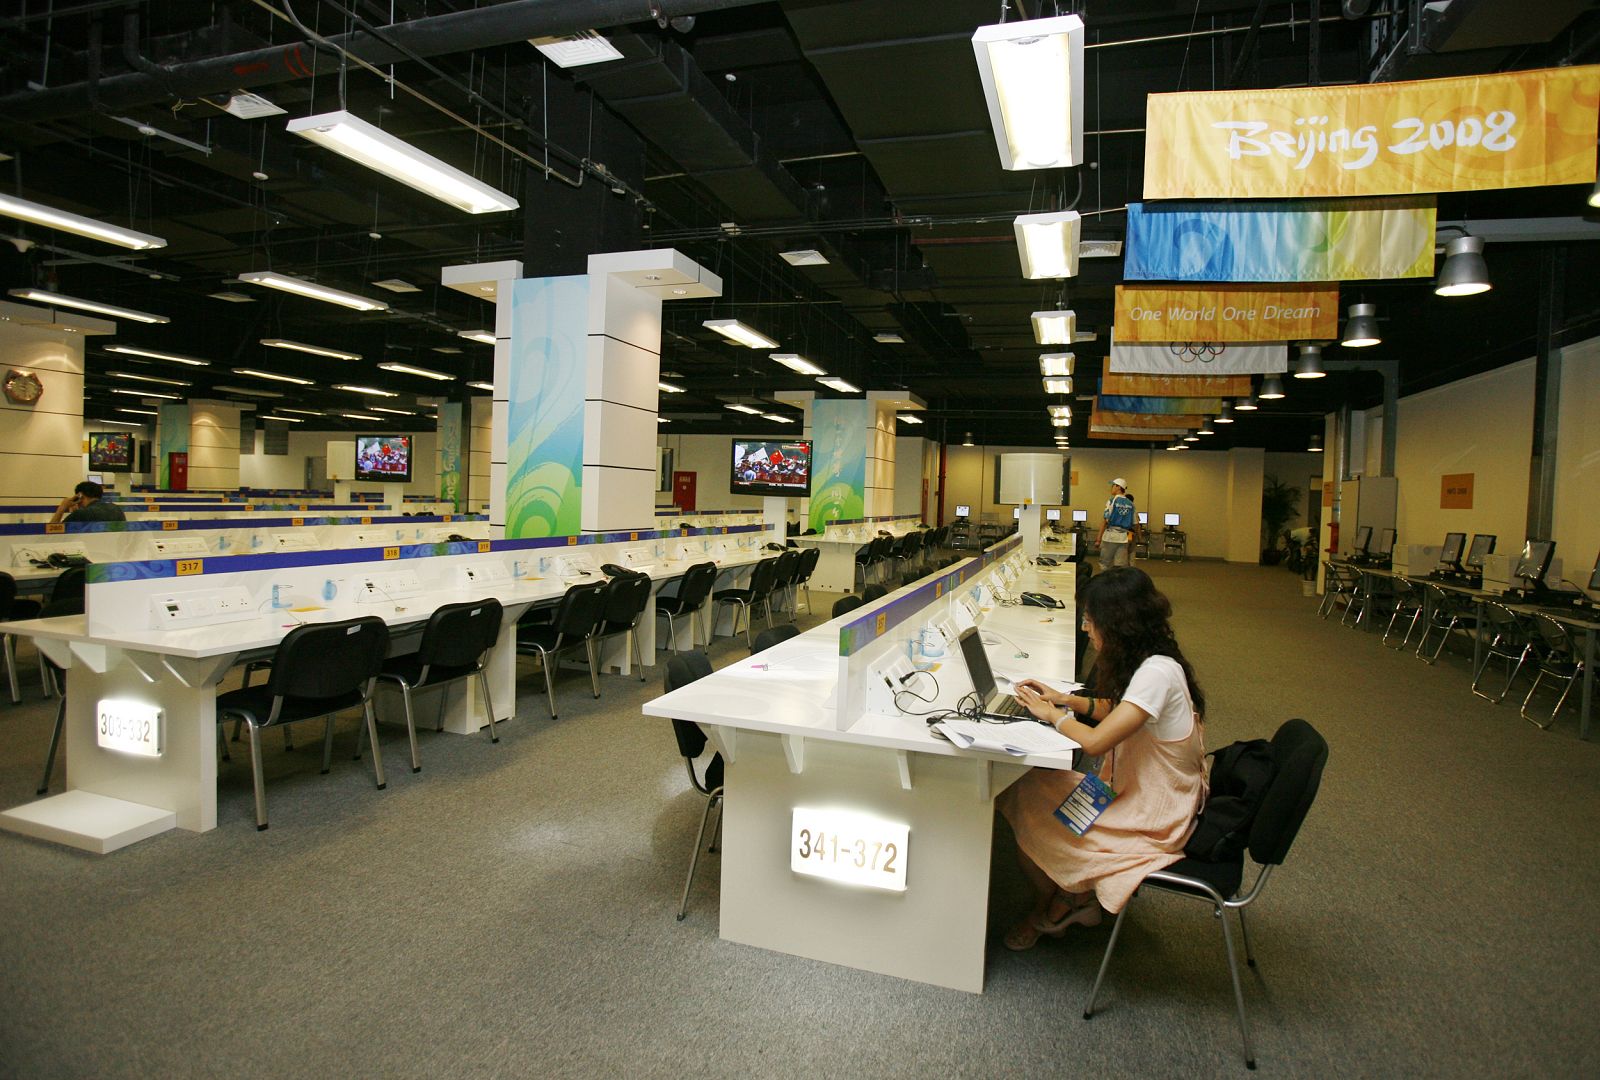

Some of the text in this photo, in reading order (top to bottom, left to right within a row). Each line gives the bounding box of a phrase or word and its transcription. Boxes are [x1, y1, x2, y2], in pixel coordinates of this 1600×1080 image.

[1210, 110, 1516, 170] Beijing 2008
[1130, 305, 1320, 321] One World One Dream
[386, 549, 398, 557] 318
[181, 562, 199, 572] 317
[101, 713, 150, 743] 303-332
[799, 828, 898, 874] 341-372
